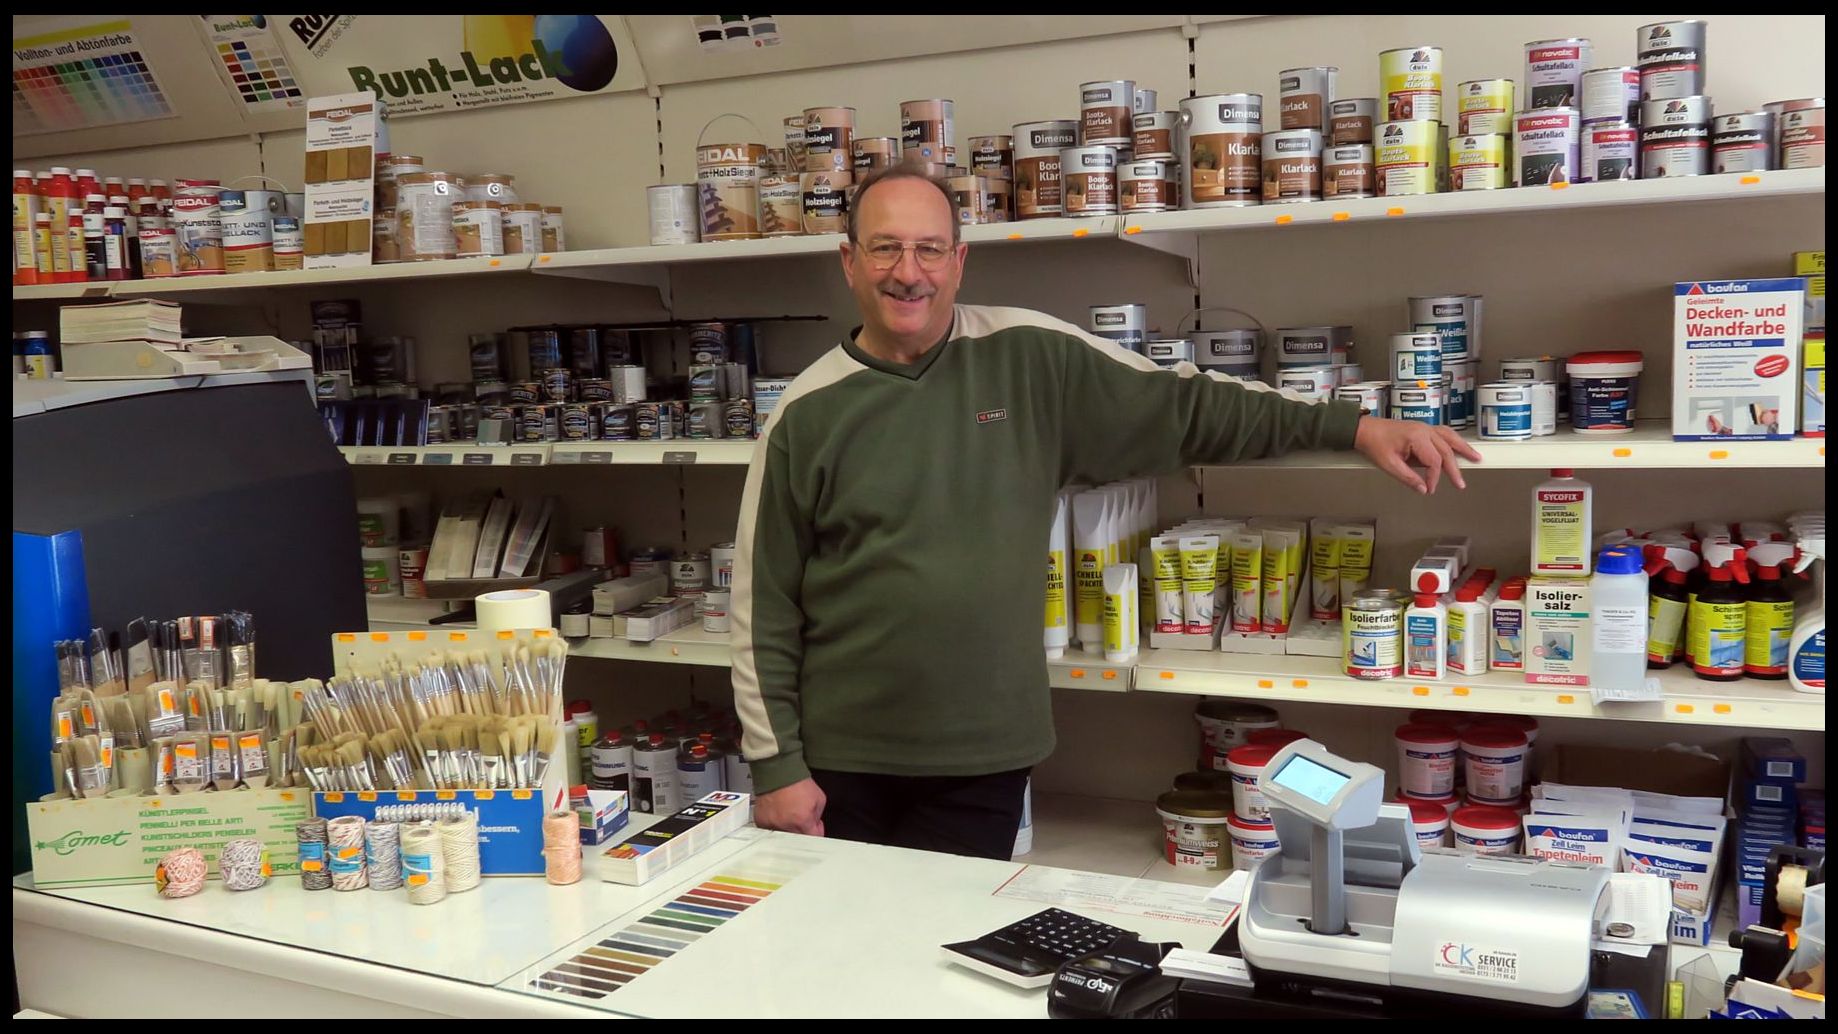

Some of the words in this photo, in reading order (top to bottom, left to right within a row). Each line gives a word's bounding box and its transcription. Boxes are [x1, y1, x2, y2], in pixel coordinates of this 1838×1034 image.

[15, 48, 53, 62] Vollton-
[55, 41, 75, 55] und
[347, 39, 573, 99] Bunt-Lack
[1531, 62, 1575, 73] Schultafellack
[1086, 111, 1107, 119] Boots-
[1223, 108, 1260, 119] Dimensa
[1086, 117, 1113, 127] Klarlack
[1335, 121, 1363, 129] Klarlack
[1034, 133, 1074, 145] Dimensa
[1521, 130, 1565, 141] Schultafellack
[1642, 127, 1709, 142] Schultafellack
[1278, 141, 1310, 150] Dimensa
[697, 148, 750, 162] EIDAL
[1084, 156, 1112, 165] Dimensa
[1281, 164, 1318, 174] Klarlack
[1338, 168, 1367, 177] Klarlack
[1087, 176, 1109, 184] Boots-
[1087, 183, 1114, 191] Klarlack
[805, 197, 842, 207] Holzsiegel
[243, 221, 267, 229] UND
[1706, 282, 1748, 294] baufan
[1686, 307, 1749, 321] Decken-
[1754, 304, 1787, 318] und
[1686, 321, 1786, 338] Wandfarbe
[1214, 342, 1252, 352] Dimensa
[1285, 340, 1324, 350] Dimensa
[1403, 410, 1434, 419] Weißlack
[1543, 493, 1577, 501] SYCOFIX
[1536, 590, 1583, 601] Isolier-
[1544, 601, 1571, 611] salz
[1360, 669, 1394, 678] decotric
[1536, 675, 1577, 684] decotric
[1558, 831, 1594, 841] baufan
[56, 830, 131, 856] Comet
[1552, 840, 1565, 848] Zell
[1567, 842, 1586, 850] Leim
[1533, 848, 1603, 864] Tapetenleim
[1654, 859, 1692, 871] baufan
[1676, 914, 1695, 922] Leim
[1478, 954, 1517, 969] SERVICE
